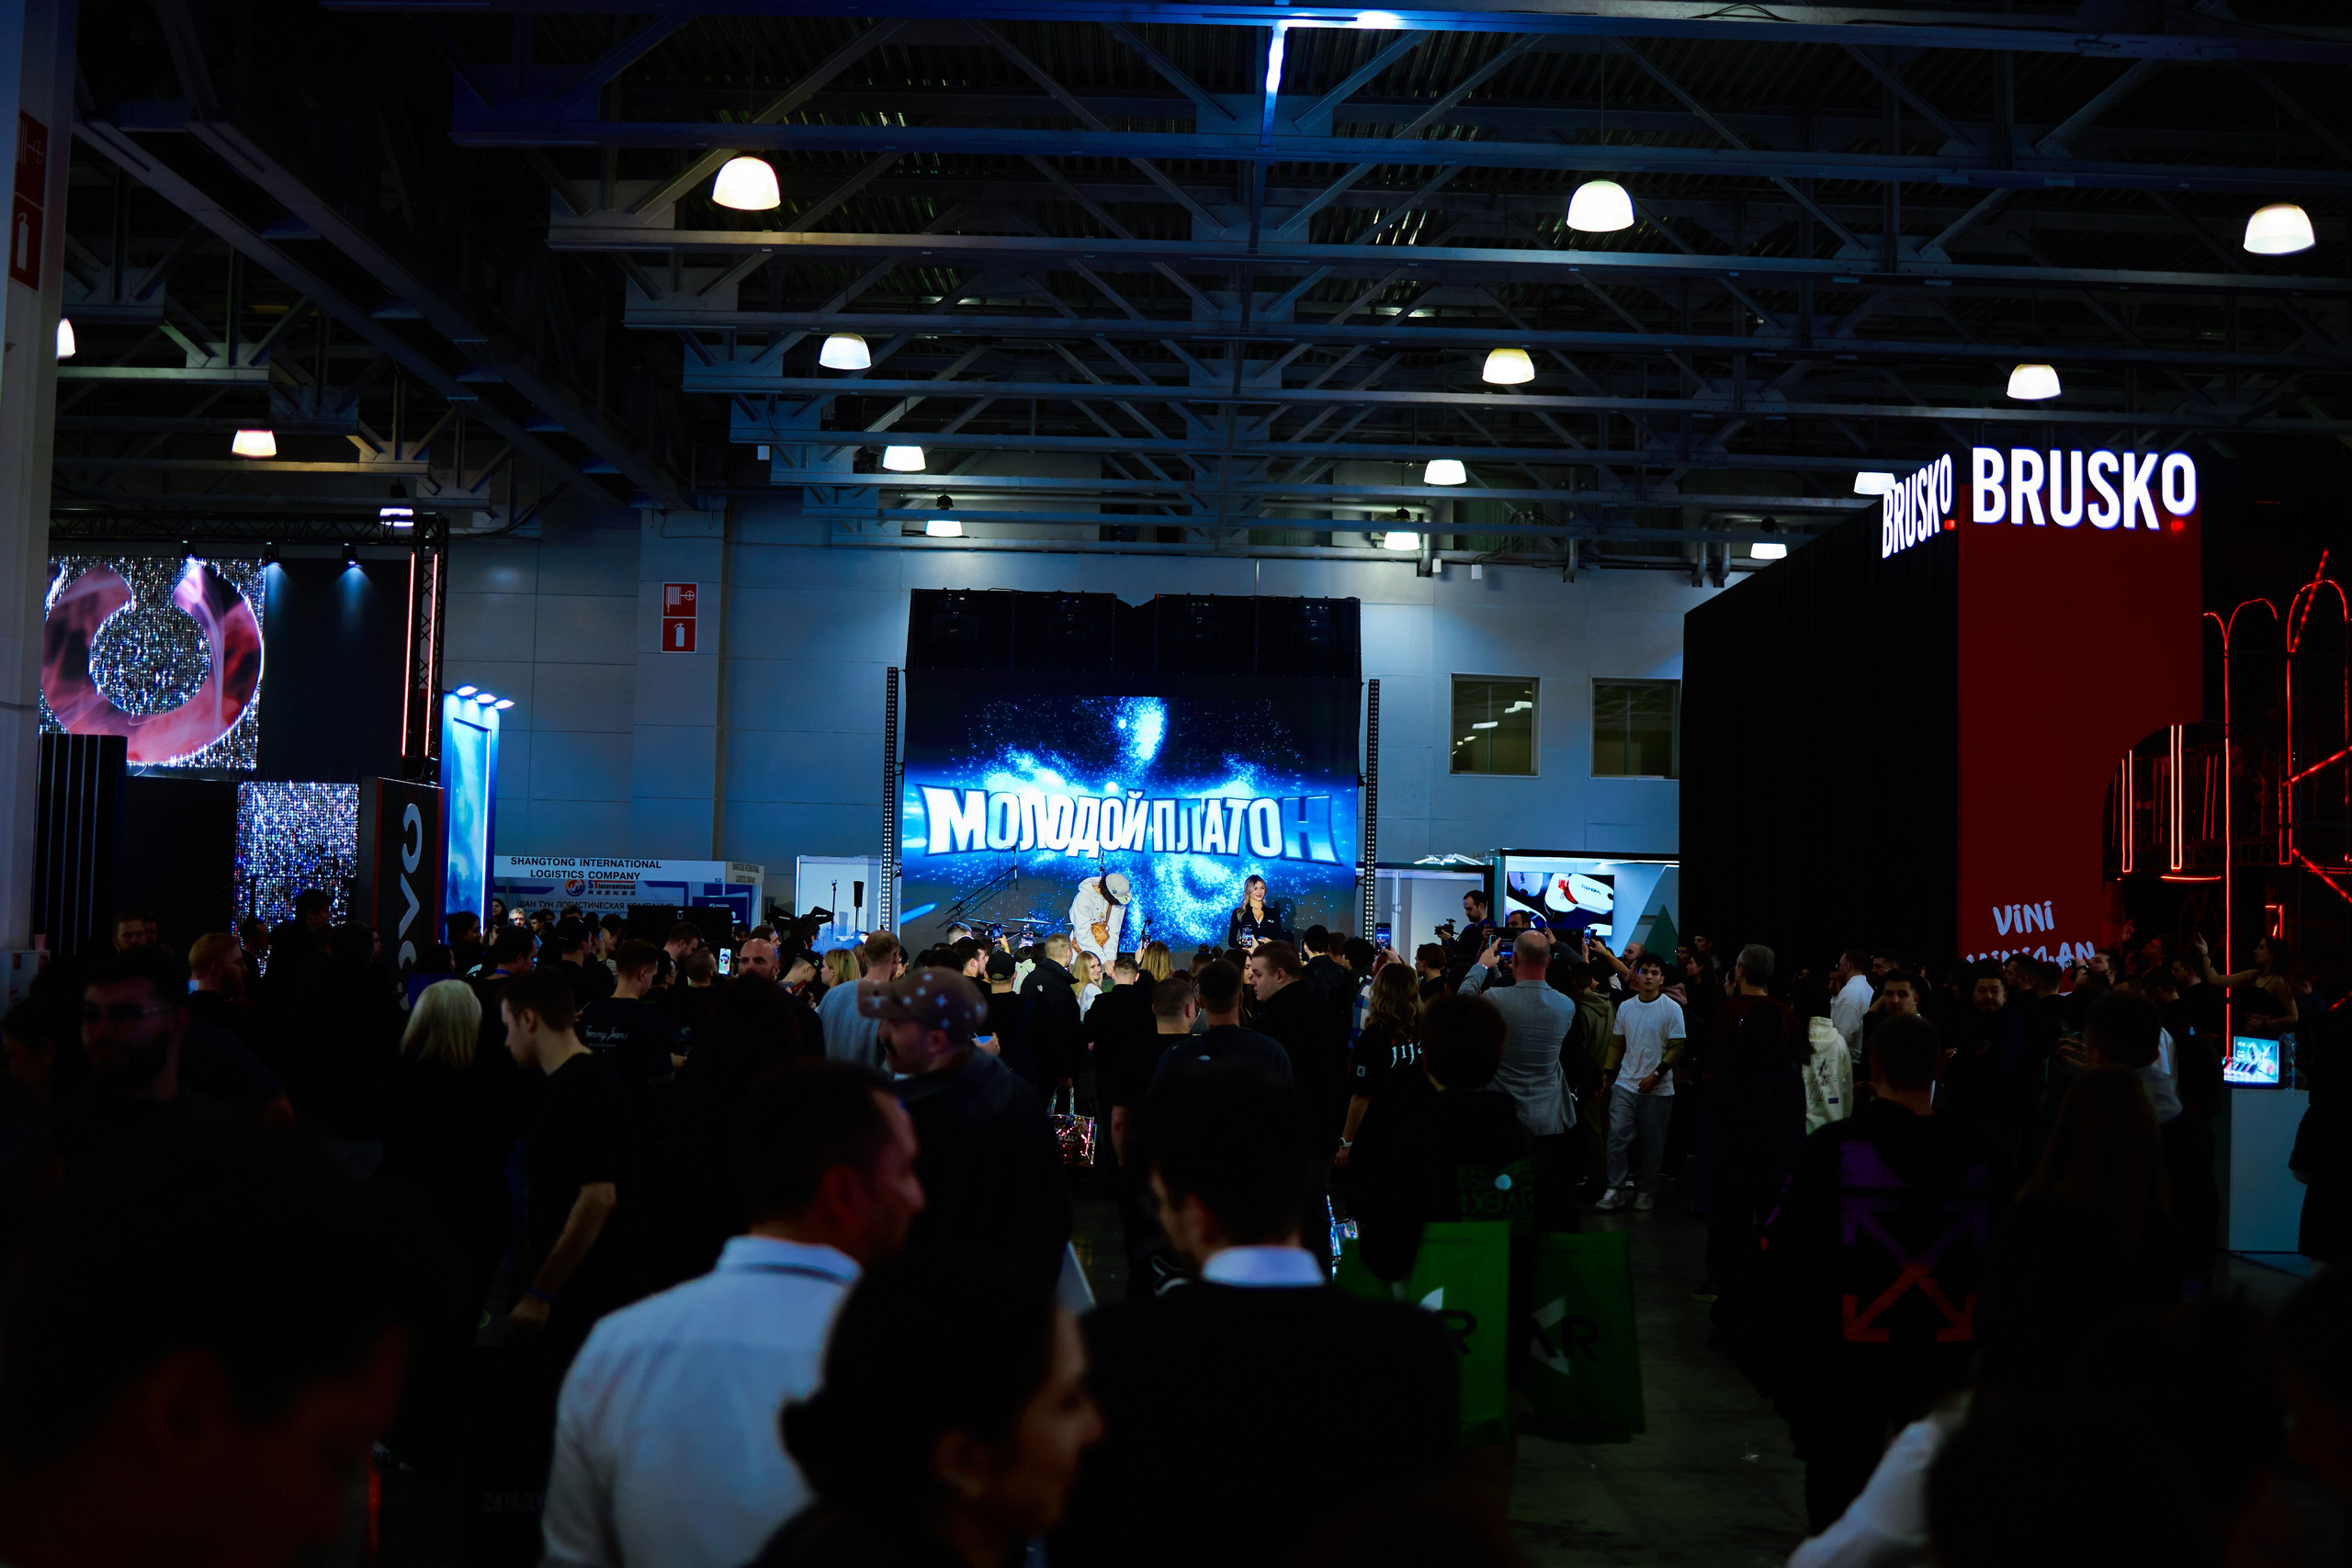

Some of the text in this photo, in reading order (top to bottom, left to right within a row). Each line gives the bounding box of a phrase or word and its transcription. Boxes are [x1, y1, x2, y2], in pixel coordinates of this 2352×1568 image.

[1882, 453, 1953, 559] BRUSKO
[1973, 446, 2197, 531] BRUSKO
[920, 785, 1344, 864] МОЛОДОЙ ПЛАТОН
[511, 857, 662, 869] SHANGTONG INTERNATIONAL
[530, 870, 641, 880] LOGISTICS COMPANY
[538, 900, 554, 908] ТУН
